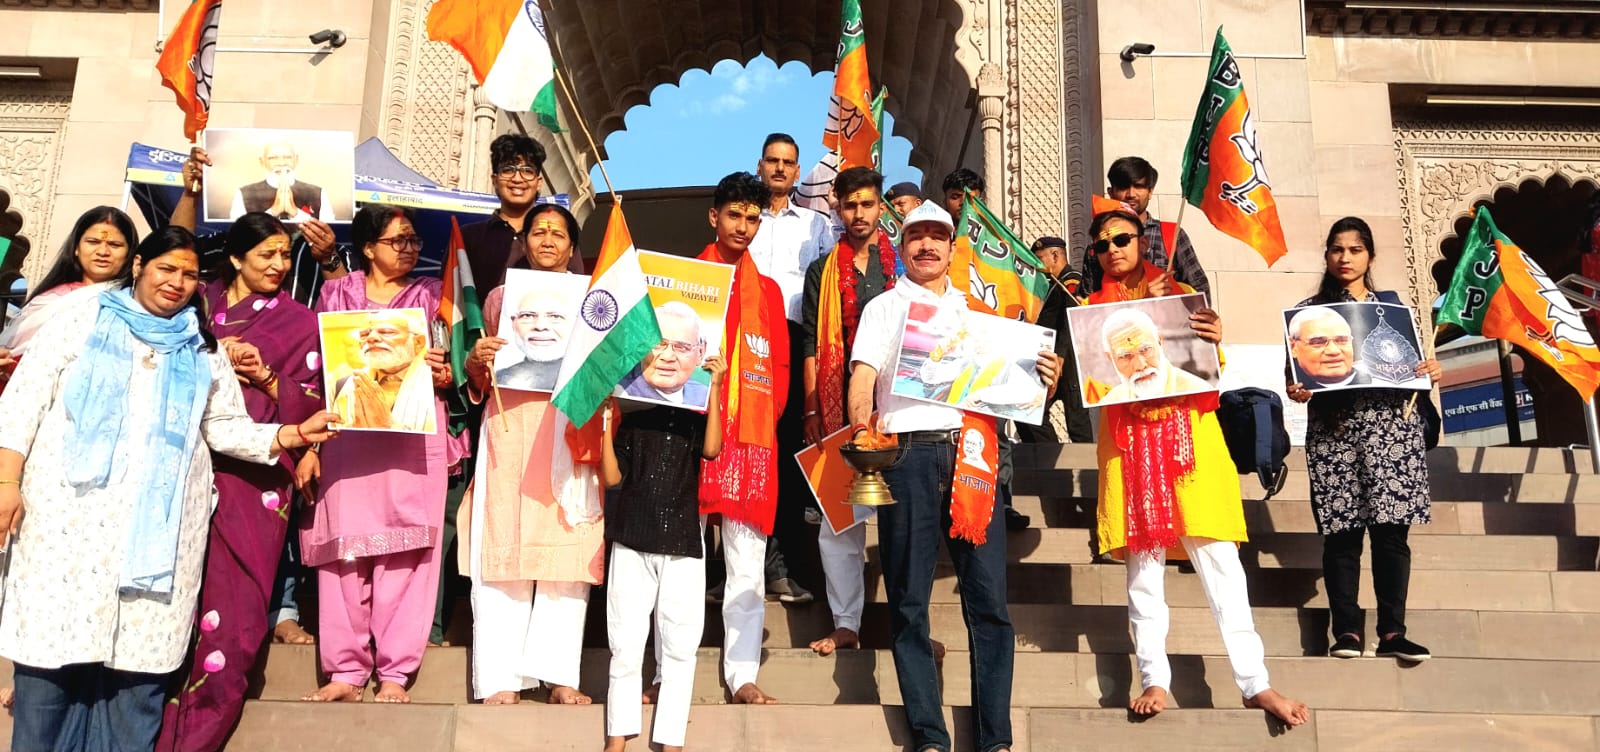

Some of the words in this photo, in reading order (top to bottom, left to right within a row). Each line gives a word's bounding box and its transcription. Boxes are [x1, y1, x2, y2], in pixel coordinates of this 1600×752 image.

[643, 275, 673, 289] ATAL
[675, 280, 721, 297] BIHARI
[959, 472, 992, 495] भाजपा
